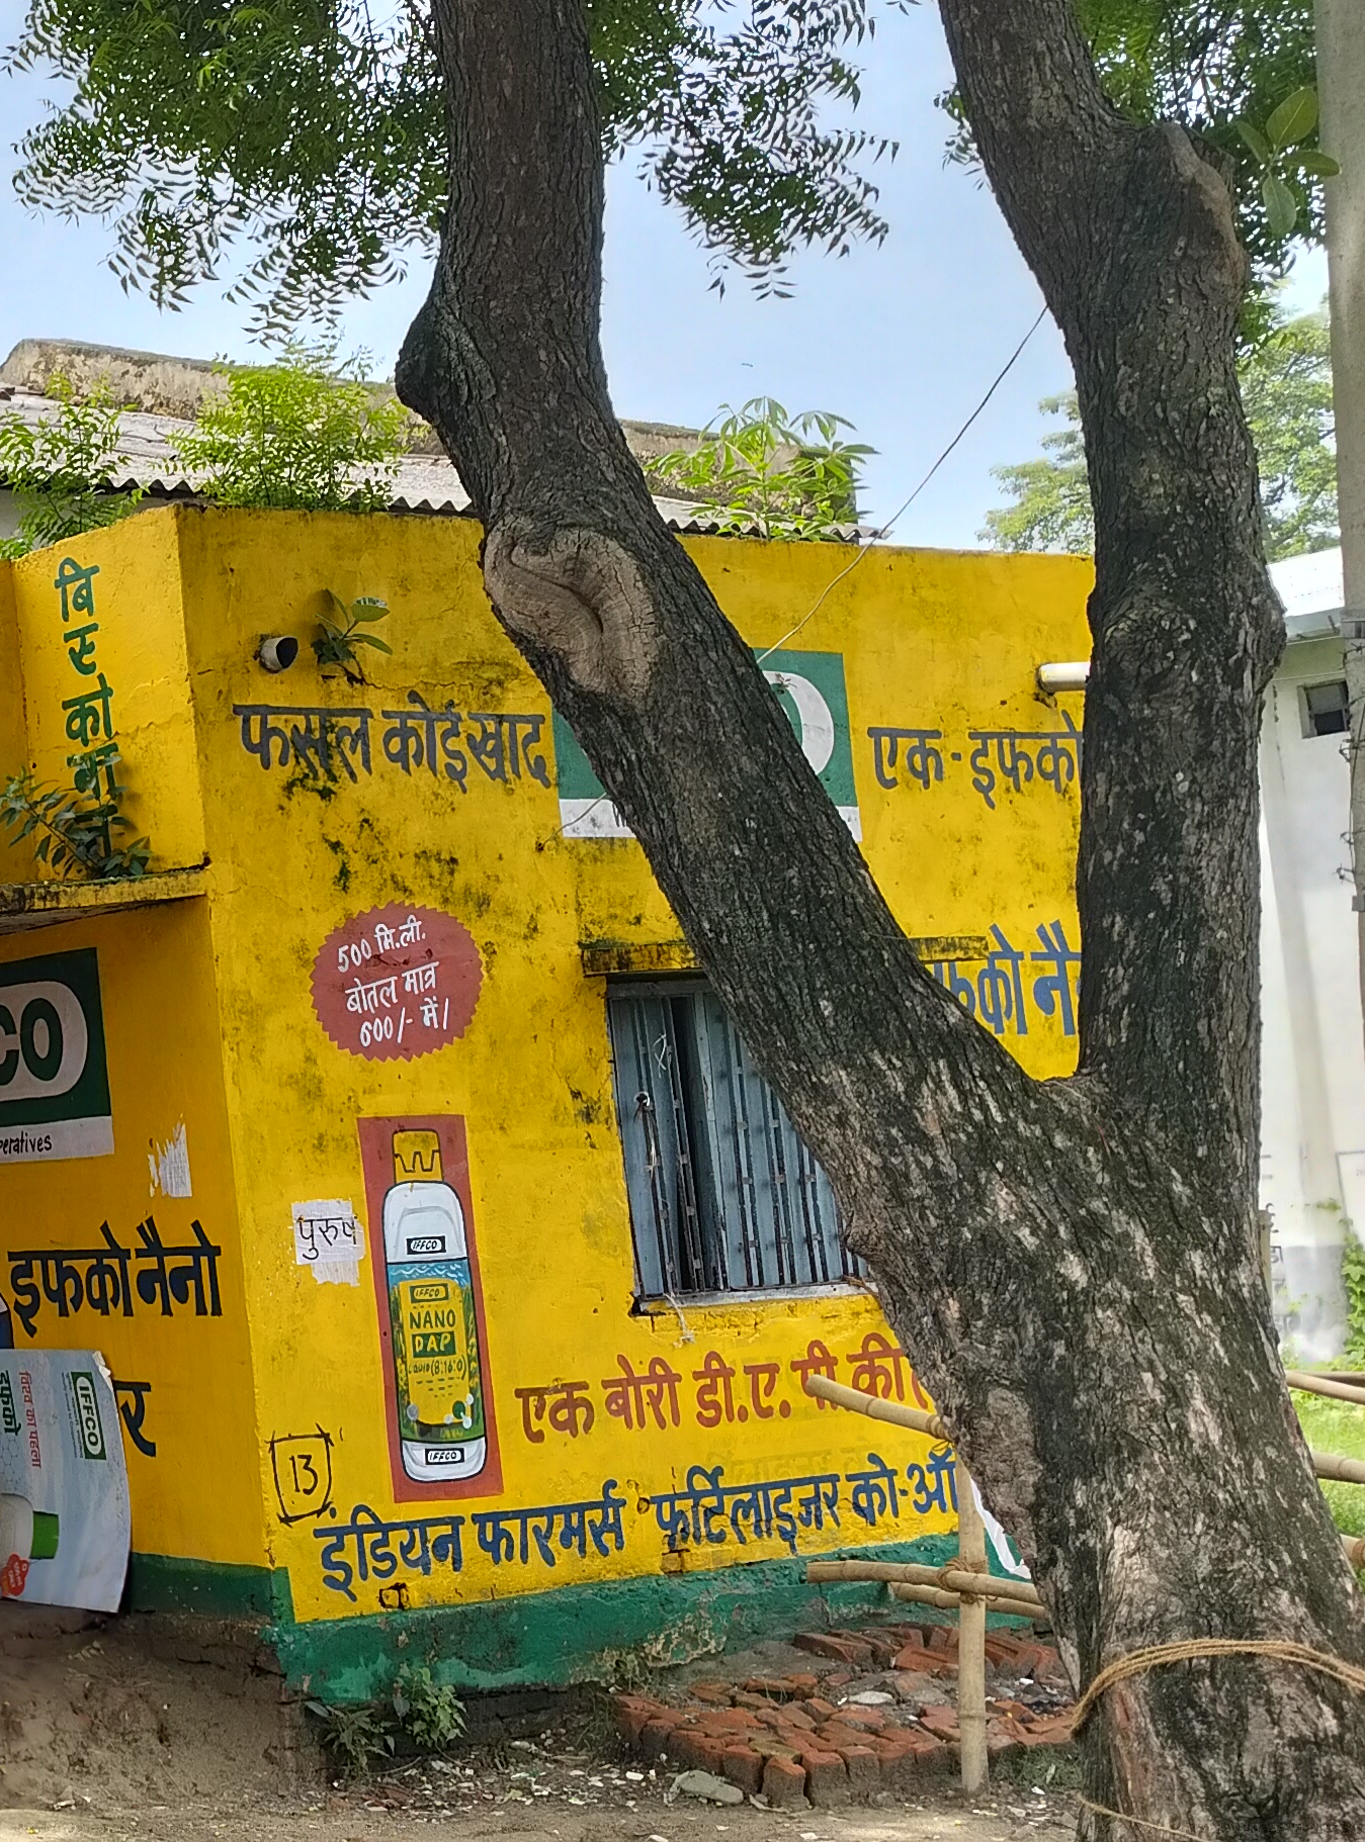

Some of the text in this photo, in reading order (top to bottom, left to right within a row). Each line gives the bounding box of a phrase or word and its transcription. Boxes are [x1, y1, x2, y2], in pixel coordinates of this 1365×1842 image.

[468, 711, 552, 788] खाद
[337, 939, 373, 974] 500
[345, 960, 440, 1015] बोतल मात्र
[358, 1001, 415, 1049] 600/-
[412, 1240, 438, 1251] IFFCO
[7, 1215, 222, 1338] इफको नैनो
[415, 1287, 440, 1298] IFFCO
[409, 1309, 457, 1331] NANO
[414, 1335, 451, 1354] DAP
[79, 1385, 99, 1447] IFFCO
[514, 1380, 594, 1443] एक
[601, 1354, 681, 1431] बोरी
[25, 1407, 43, 1469] का पहला
[429, 1452, 457, 1462] IFFCO
[314, 1502, 465, 1602] इंडियन
[472, 1479, 626, 1566] फारमर्स
